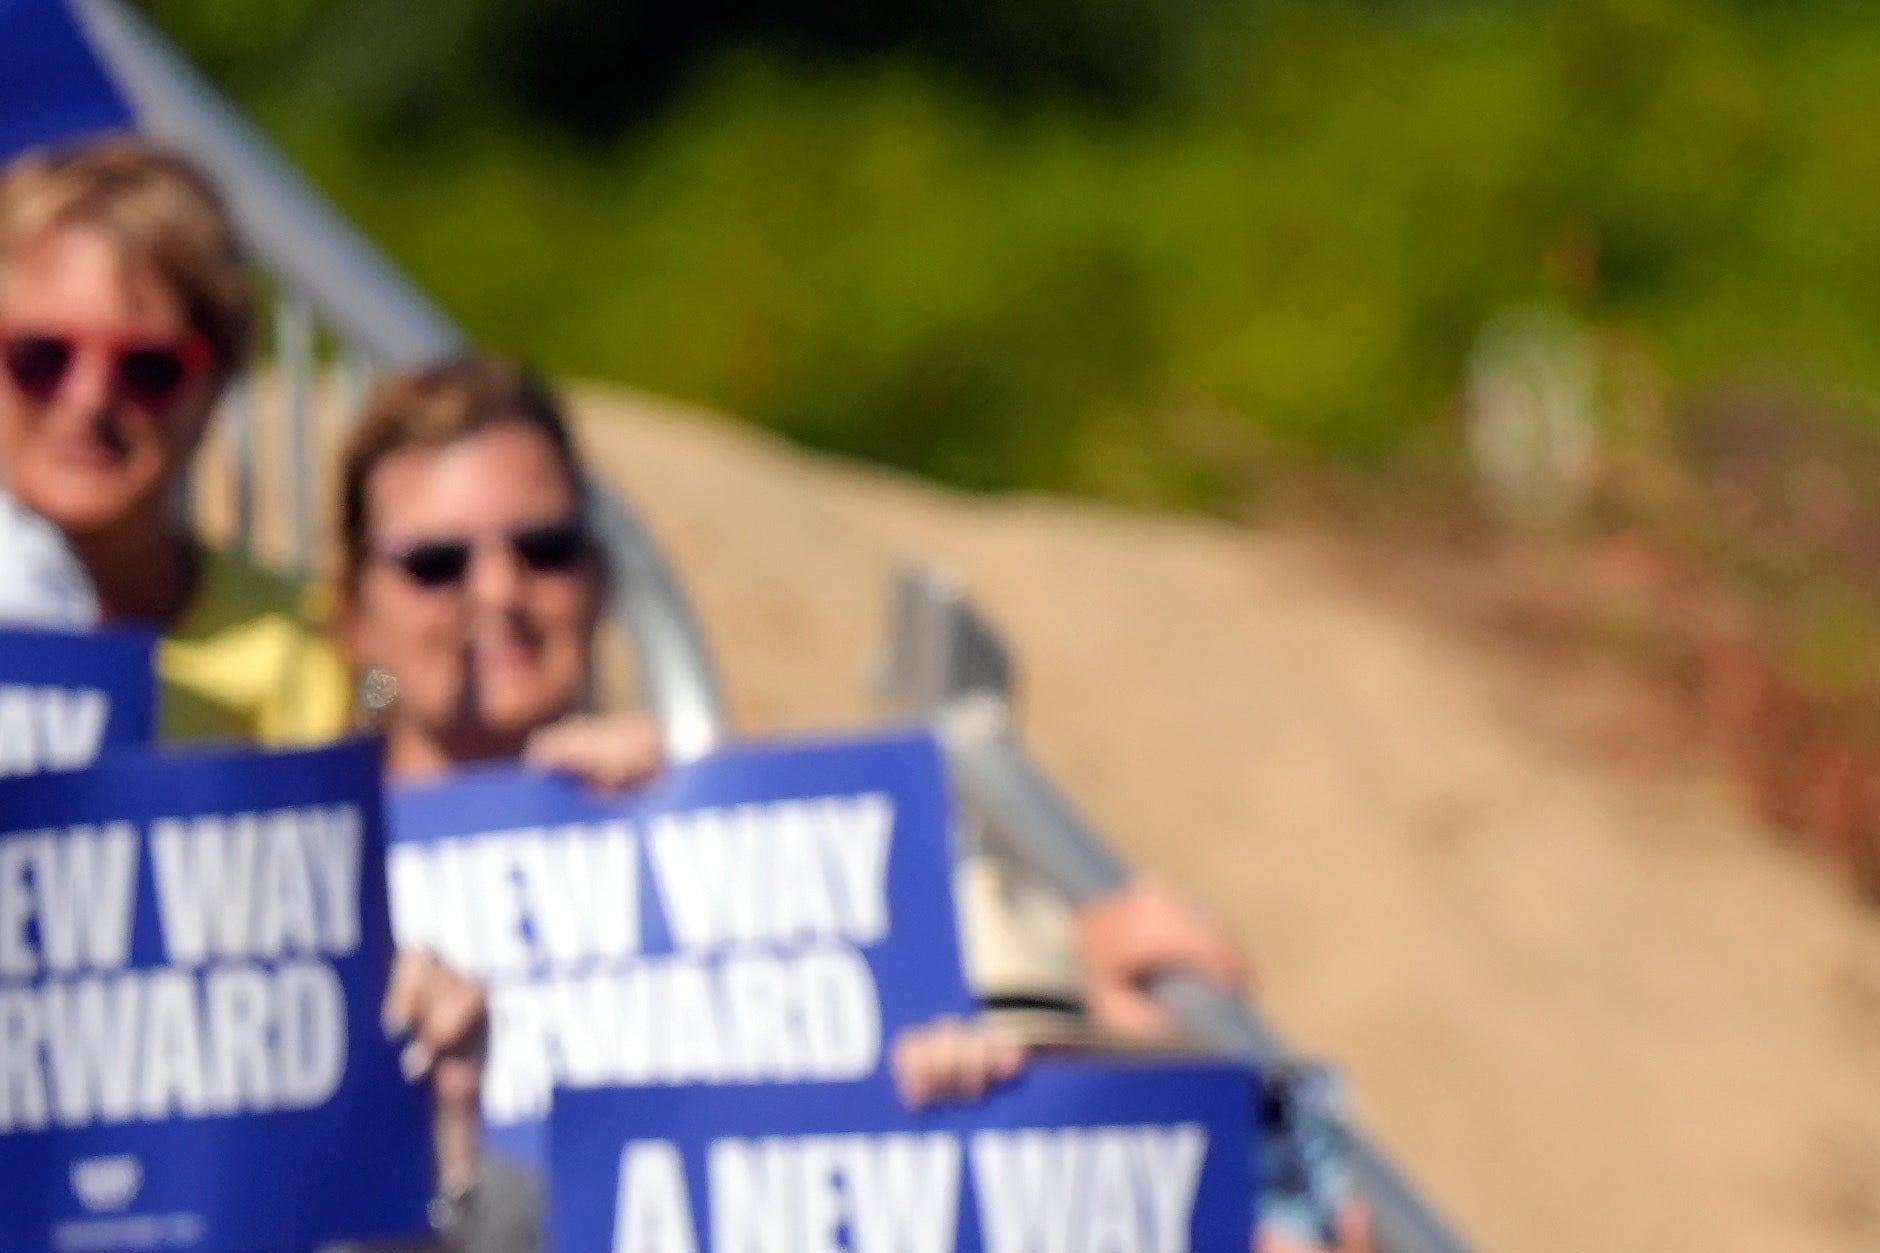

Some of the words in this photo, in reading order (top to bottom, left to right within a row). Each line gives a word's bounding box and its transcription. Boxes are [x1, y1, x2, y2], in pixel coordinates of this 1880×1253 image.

[150, 803, 362, 962] WAY
[388, 818, 640, 970] NEW
[645, 791, 895, 957] WAY
